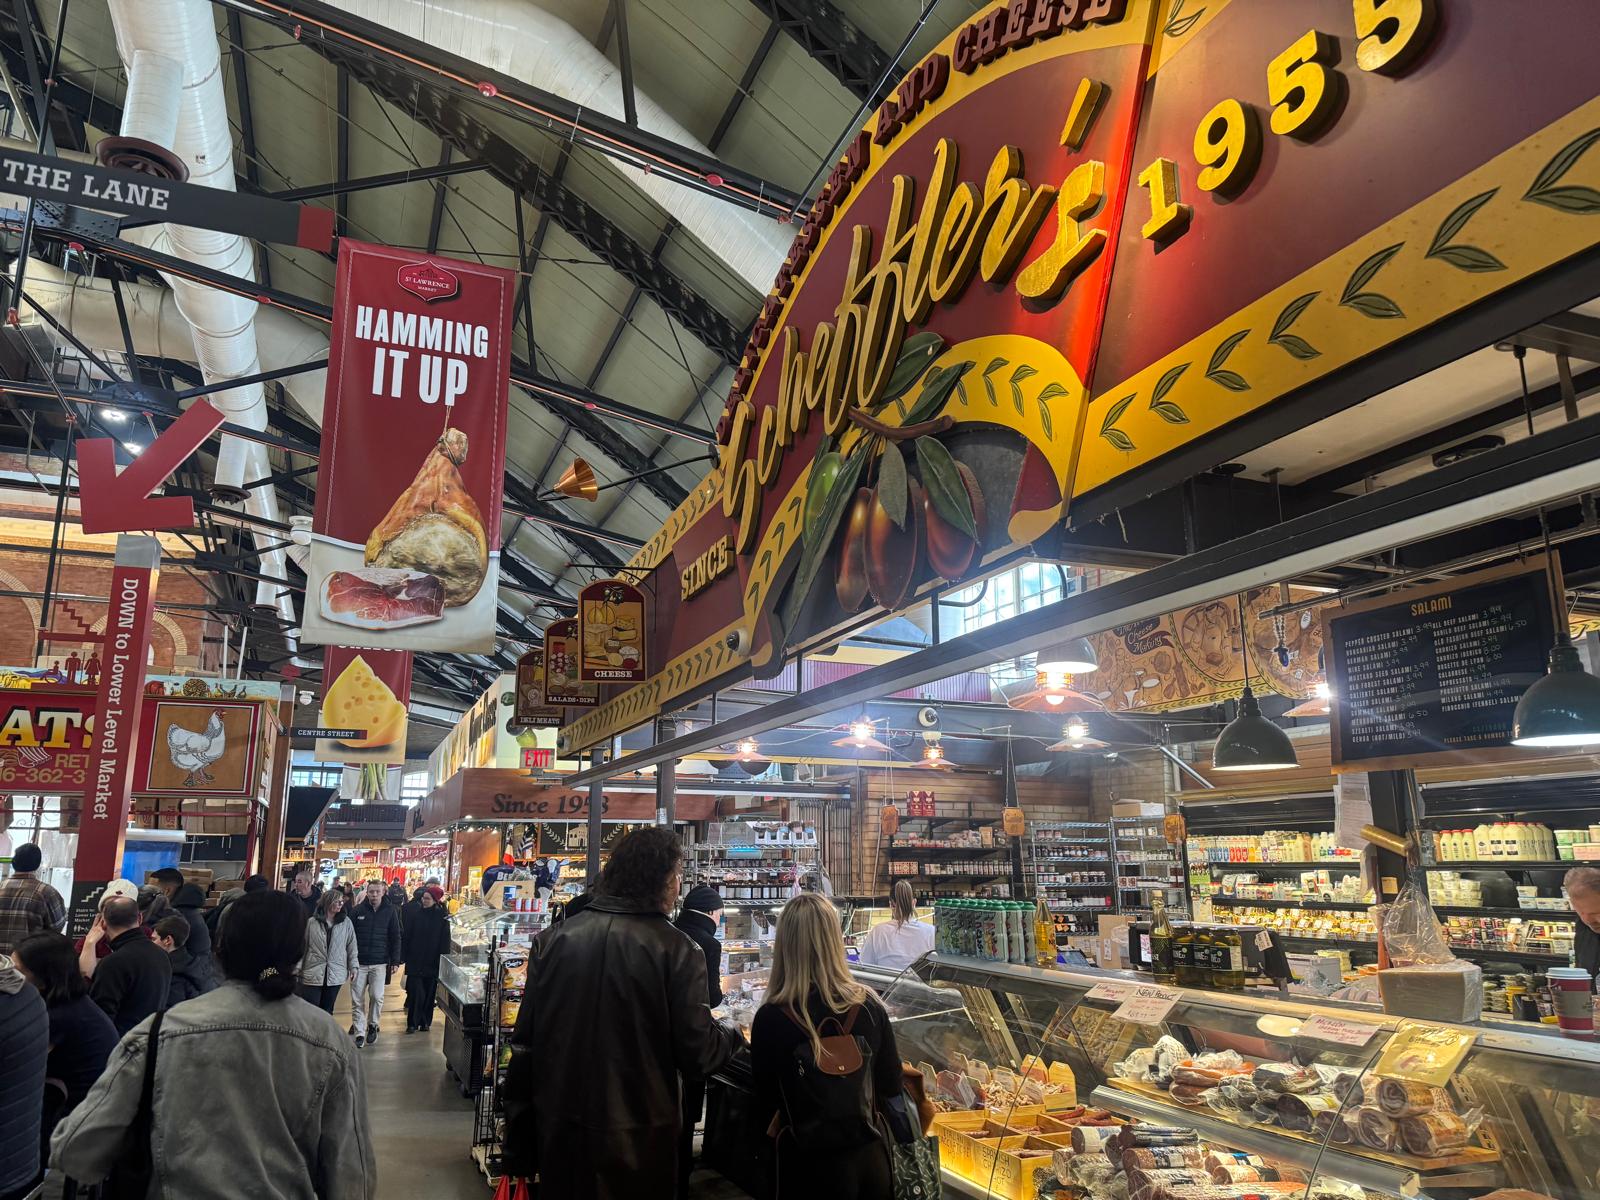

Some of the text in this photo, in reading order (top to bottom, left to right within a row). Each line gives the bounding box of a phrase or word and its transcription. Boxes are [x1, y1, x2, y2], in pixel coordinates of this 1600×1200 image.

[1138, 0, 1424, 242] 1955
[3, 159, 171, 211] THE LANE
[716, 0, 1127, 446] DELICATESSEN AND CHEESE
[413, 278, 450, 289] LAWRENCE
[355, 304, 490, 359] HAMMING
[371, 346, 470, 407] IT UP
[681, 540, 736, 601] SINCE
[1411, 596, 1452, 616] SALAMI
[1458, 613, 1479, 623] SALAMI
[1468, 620, 1490, 629] SALAMI
[1485, 625, 1507, 634] SALAMI
[1127, 623, 1153, 645] Cheese
[1392, 627, 1413, 638] SALAMI
[1133, 636, 1163, 654] Making
[1378, 640, 1398, 650] SALAMI
[1459, 640, 1480, 650] SALAMI
[1371, 651, 1391, 661] SALAMI
[1363, 661, 1383, 670] SALAMI
[1391, 665, 1412, 676] SALAMI
[594, 669, 633, 679] CHEESE
[1383, 676, 1404, 686] SALAMI
[1471, 681, 1492, 691] SALAMI
[1377, 687, 1398, 696] SALAMI
[1463, 691, 1485, 700] SALAMI
[93, 578, 139, 820] DOWN to Lower Level Market
[520, 716, 560, 725] DELI MEATS
[1384, 713, 1406, 722] SALAMI
[1376, 724, 1397, 732] SALAMI
[297, 729, 355, 738] CENTRE STREET
[524, 751, 550, 768] EXIT
[491, 792, 549, 815] Since
[983, 1158, 1012, 1179] CHRIZO
